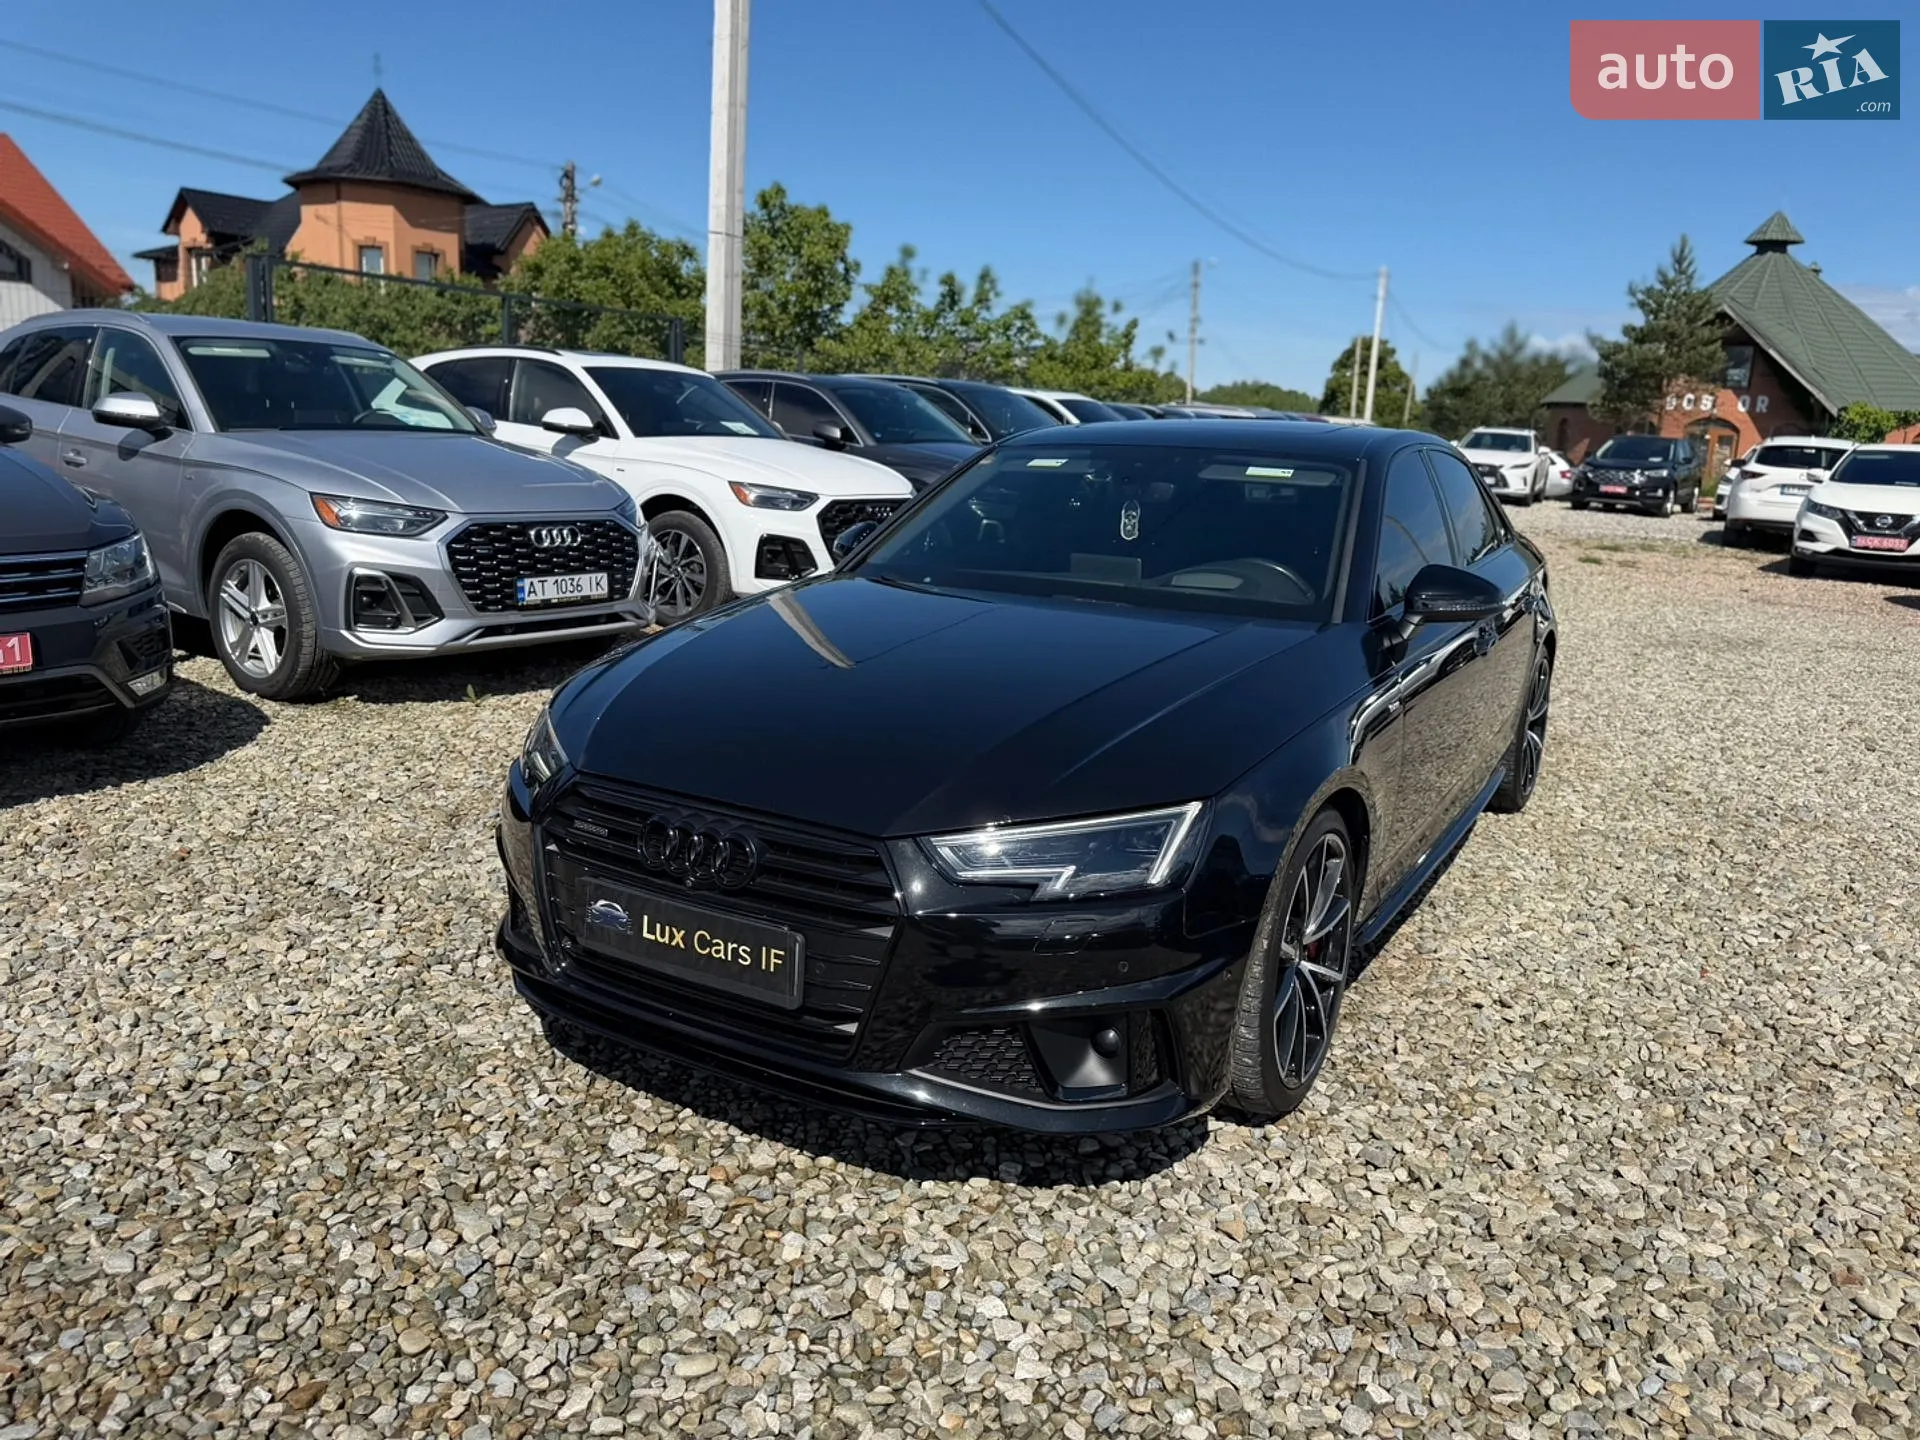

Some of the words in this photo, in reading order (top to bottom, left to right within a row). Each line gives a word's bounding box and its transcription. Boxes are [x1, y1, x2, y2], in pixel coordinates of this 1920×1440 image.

[527, 579, 548, 597] AT
[552, 577, 584, 595] 1036
[589, 574, 606, 593] IK
[0, 636, 21, 664] 1
[642, 914, 686, 949] Lux
[693, 930, 752, 966] Cars
[761, 946, 786, 973] IF
